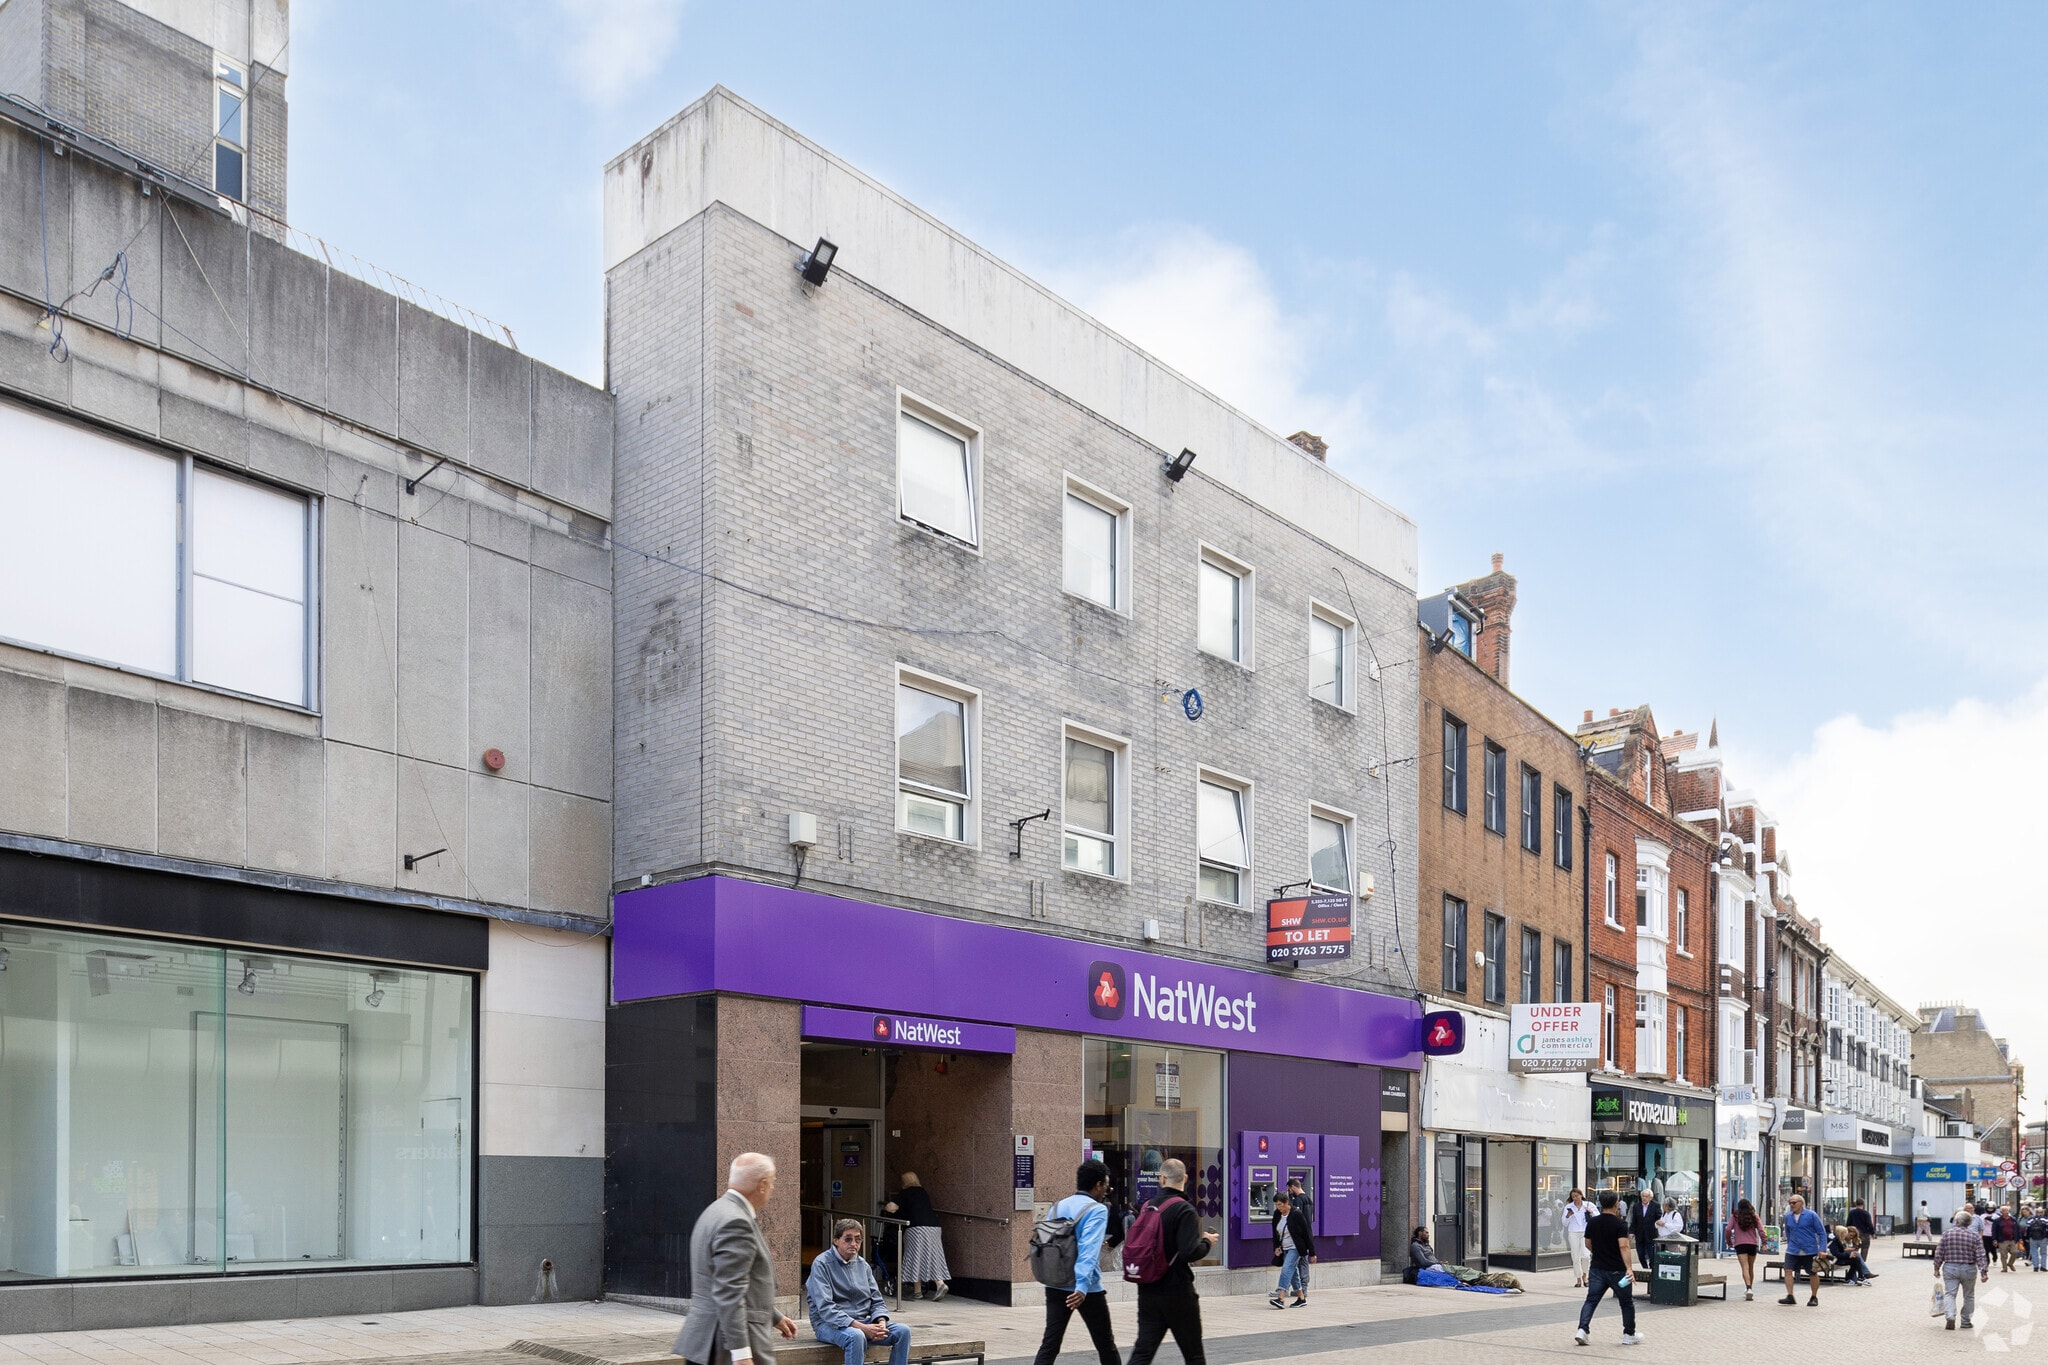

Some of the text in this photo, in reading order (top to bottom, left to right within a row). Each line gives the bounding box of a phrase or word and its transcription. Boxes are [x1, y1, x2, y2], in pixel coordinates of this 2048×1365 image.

[1281, 918, 1301, 926] SHW
[1285, 930, 1330, 942] TO LET
[1271, 945, 1345, 958] 020 3763 7575
[1133, 972, 1256, 1033] NatWest
[1530, 1006, 1582, 1017] UNDER
[895, 1020, 961, 1045] NatWest
[1531, 1021, 1579, 1032] OFFER
[1629, 1100, 1677, 1125] FOOTASYLUM
